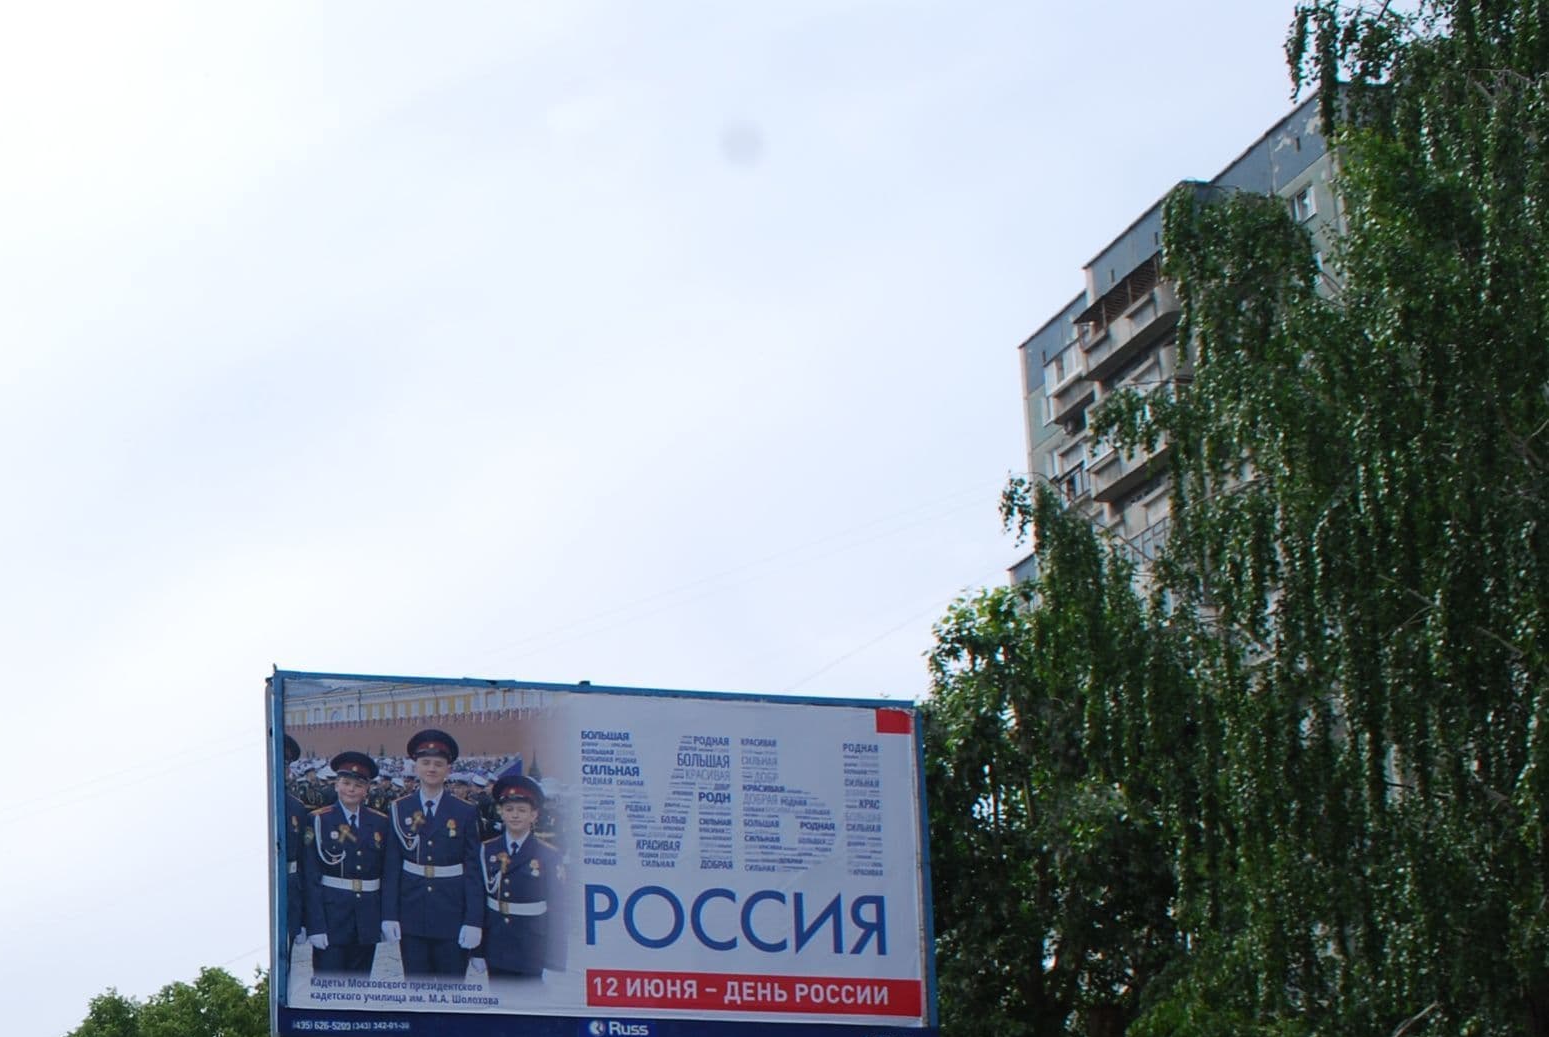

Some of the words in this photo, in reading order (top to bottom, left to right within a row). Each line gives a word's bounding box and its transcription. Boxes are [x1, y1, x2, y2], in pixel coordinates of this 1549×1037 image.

[581, 730, 630, 741] БОЛЬШАЯ
[693, 736, 730, 746] РОДНАЯ
[843, 743, 879, 753] РОДНАЯ
[677, 753, 730, 768] БОЛЬШАЯ
[582, 764, 640, 777] СИЛЬНАЯ
[685, 769, 731, 781] КРАСИВАЯ
[844, 778, 880, 788] СИЛЬНАЯ
[698, 792, 731, 804] РОДН
[859, 799, 880, 810] КРАС
[583, 823, 616, 836] СИЛ
[800, 821, 836, 831] РОДНАЯ
[846, 824, 881, 833] СИЛЬНАЯ
[636, 840, 681, 851] КРАСИВАЯ
[641, 860, 675, 868] СИЛЬНАЯ
[700, 860, 733, 870] ДОБРАЯ
[584, 883, 888, 956] РОССИЯ
[310, 977, 345, 989] Кадеты
[348, 978, 407, 990] Московского
[410, 982, 483, 993] президентского
[593, 977, 619, 997] 12
[626, 978, 698, 1000] ИЮНЯ
[723, 981, 788, 1004] ДЕНЬ
[796, 982, 890, 1006] РОССИИ
[310, 992, 362, 1002] кадетского
[364, 994, 407, 1004] училища
[429, 994, 449, 1004] М.А.
[452, 996, 499, 1006] Шолохова
[609, 1020, 649, 1036] Russ
